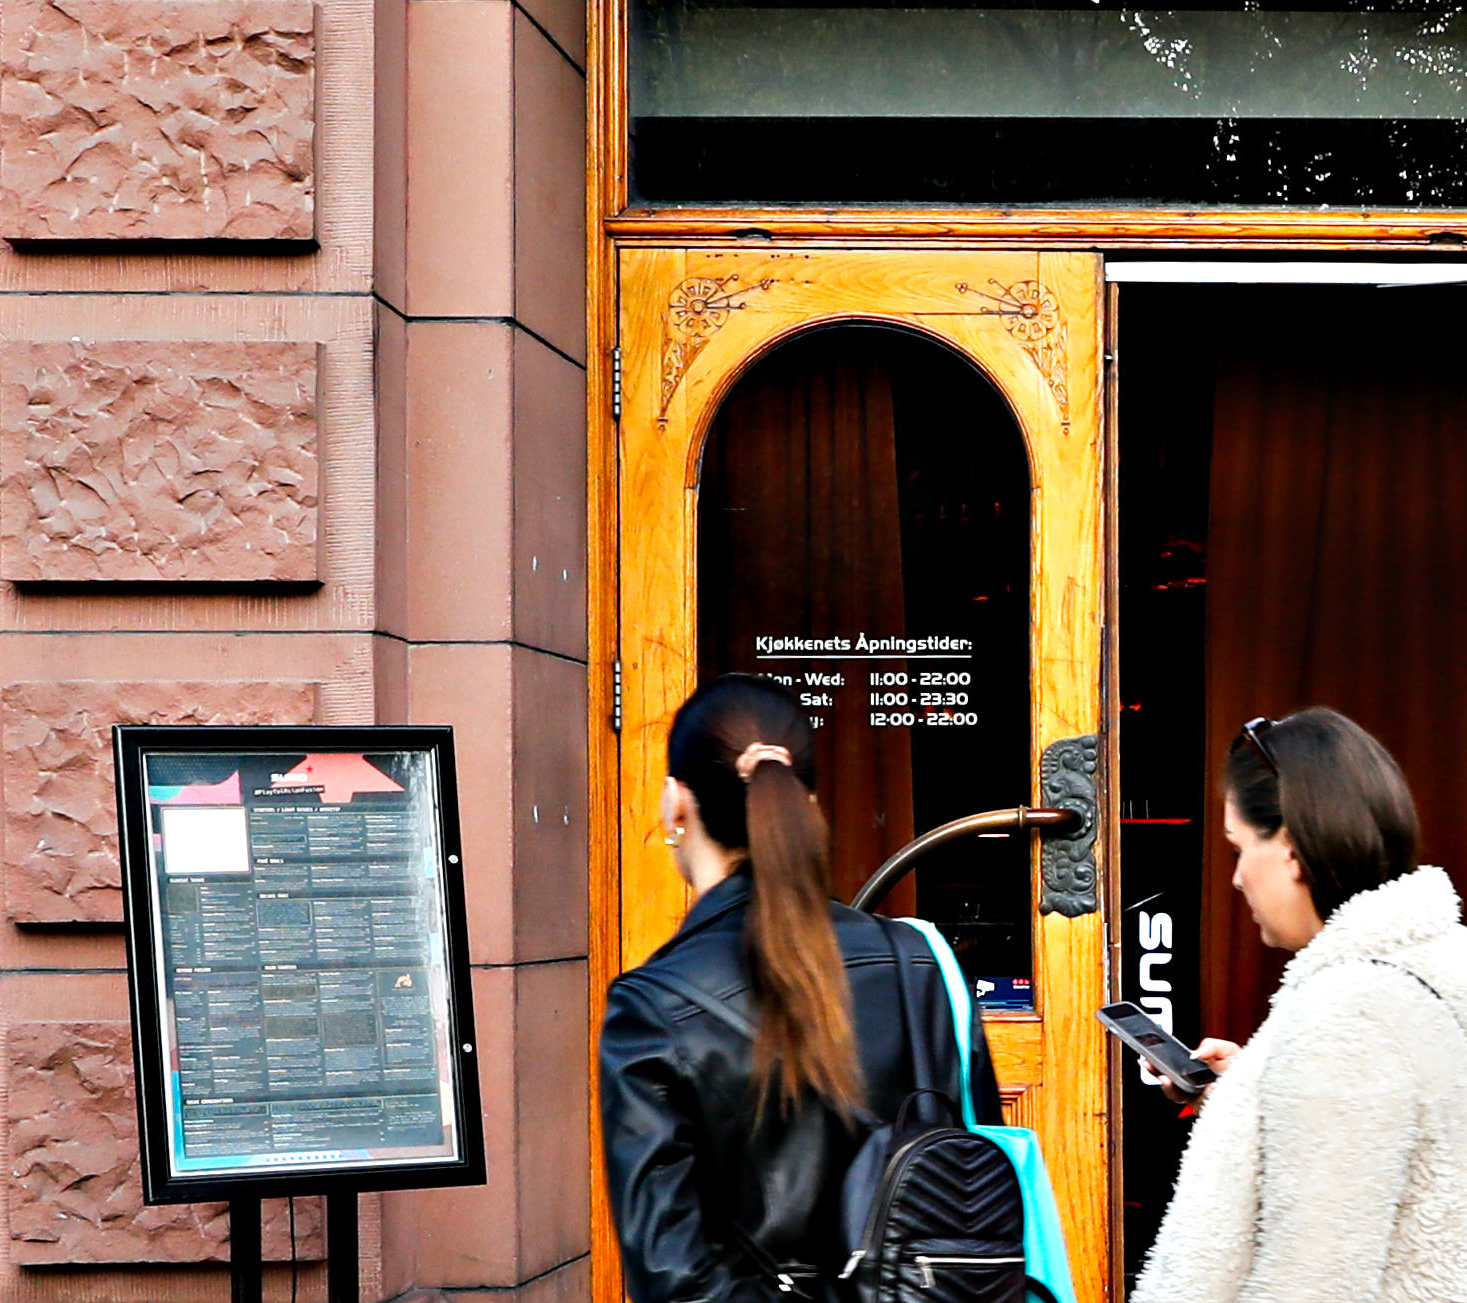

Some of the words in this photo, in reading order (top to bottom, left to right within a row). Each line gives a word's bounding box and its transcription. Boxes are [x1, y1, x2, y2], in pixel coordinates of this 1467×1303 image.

[756, 635, 851, 654] Kjøkkenets
[855, 632, 973, 654] Åpningstider:
[804, 672, 846, 686] Wed:
[870, 672, 908, 686] 11:00
[920, 672, 971, 686] 22:00
[799, 693, 833, 706] Sat:
[870, 692, 909, 706] 11:00
[920, 692, 969, 706] 23:30
[927, 713, 978, 726] 22:00
[1138, 910, 1173, 1086] SUM
